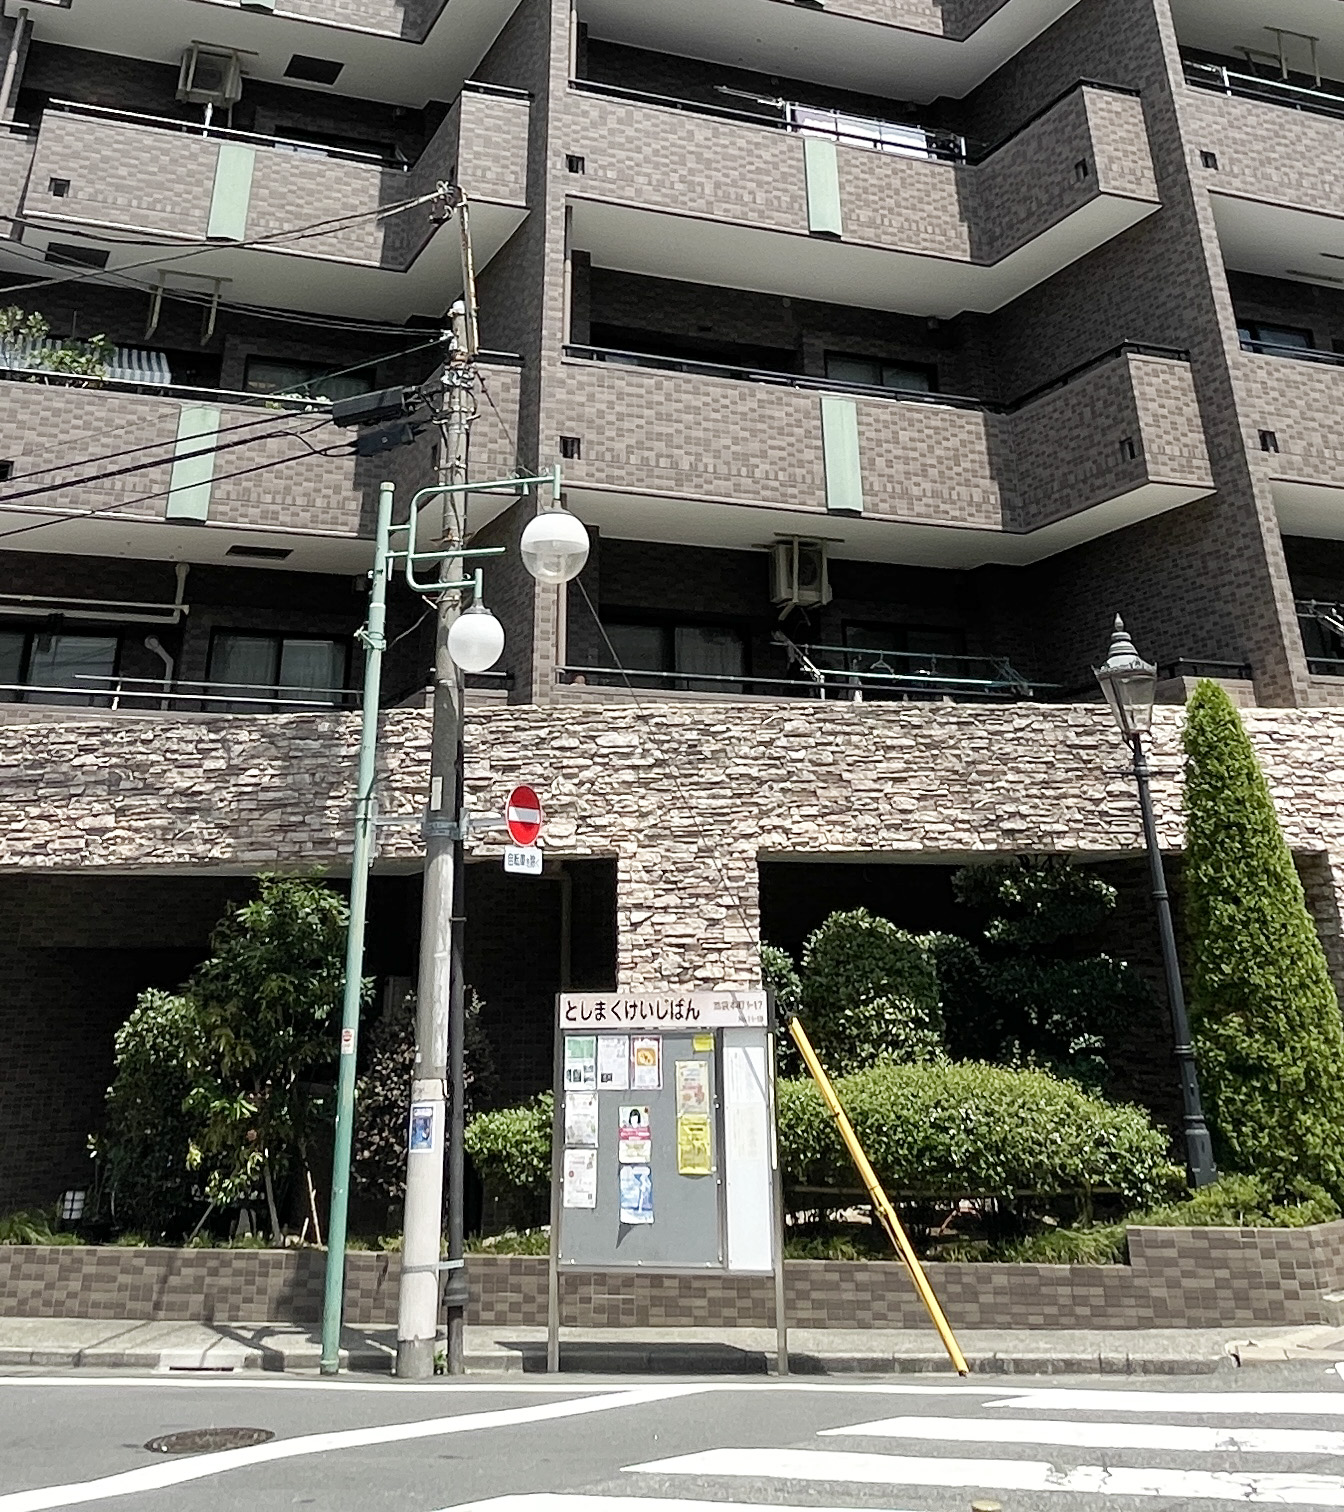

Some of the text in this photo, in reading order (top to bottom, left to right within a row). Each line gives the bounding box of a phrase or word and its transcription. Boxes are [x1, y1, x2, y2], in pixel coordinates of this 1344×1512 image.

[565, 998, 700, 1021] としまくけいじばん
